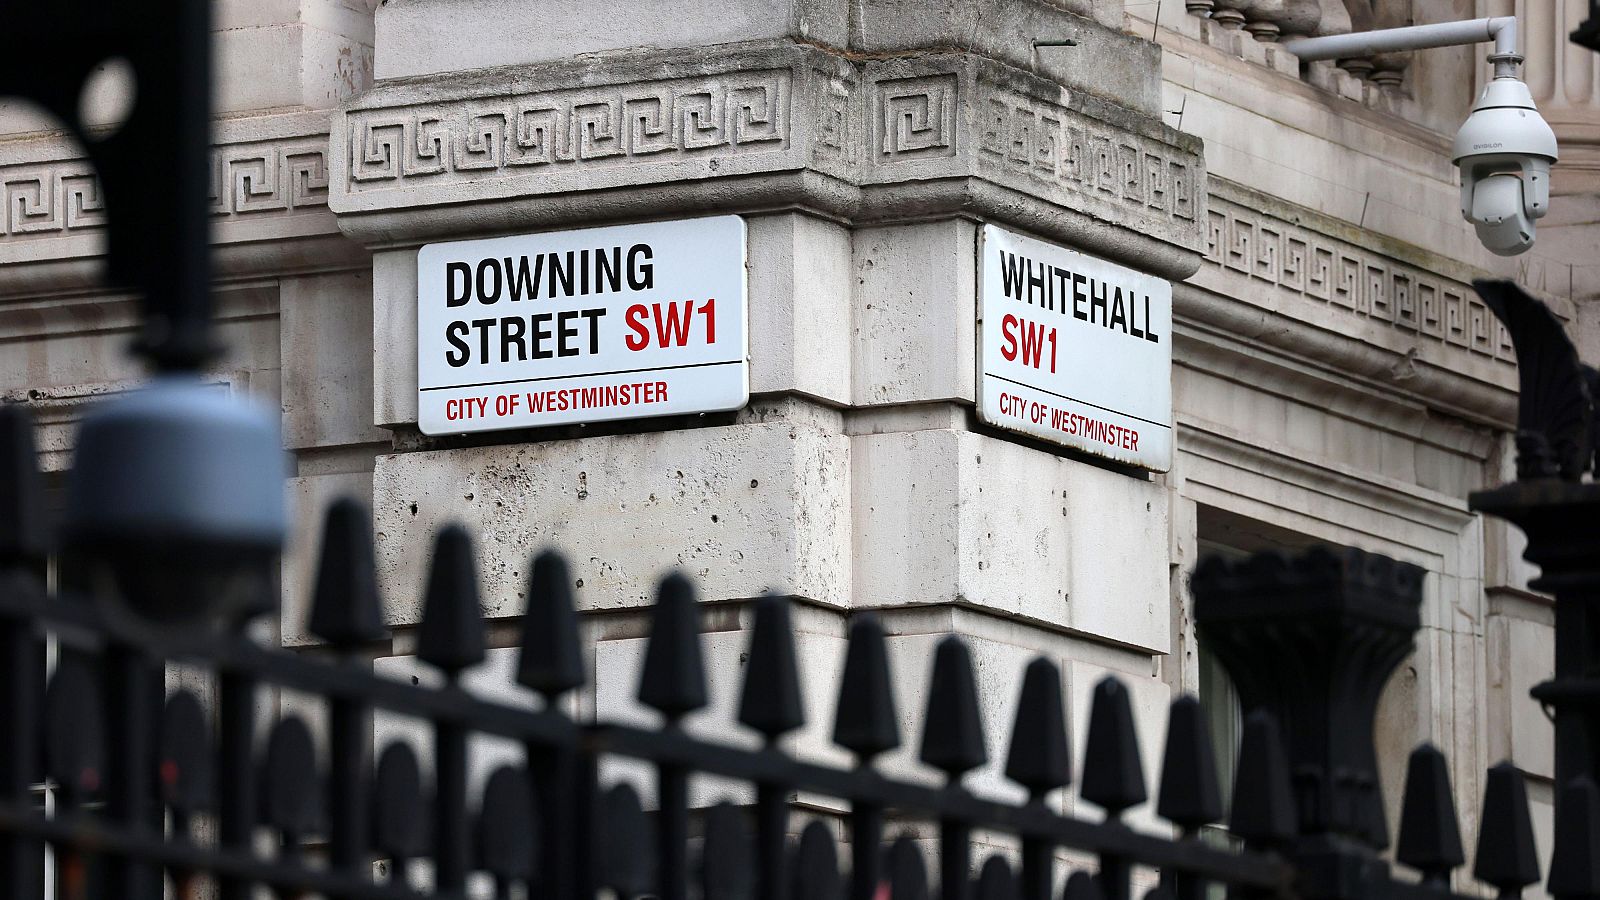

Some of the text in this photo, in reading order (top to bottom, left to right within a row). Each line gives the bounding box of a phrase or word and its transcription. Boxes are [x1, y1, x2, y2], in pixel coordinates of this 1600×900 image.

[446, 243, 654, 308] DOWNING
[999, 249, 1159, 344] WHITEHALL
[445, 298, 716, 368] STREET SW1
[1000, 313, 1057, 374] SW1
[446, 381, 669, 421] CITY OF WESTMINSTER
[999, 392, 1139, 452] CITY OF WESTMINSTER
